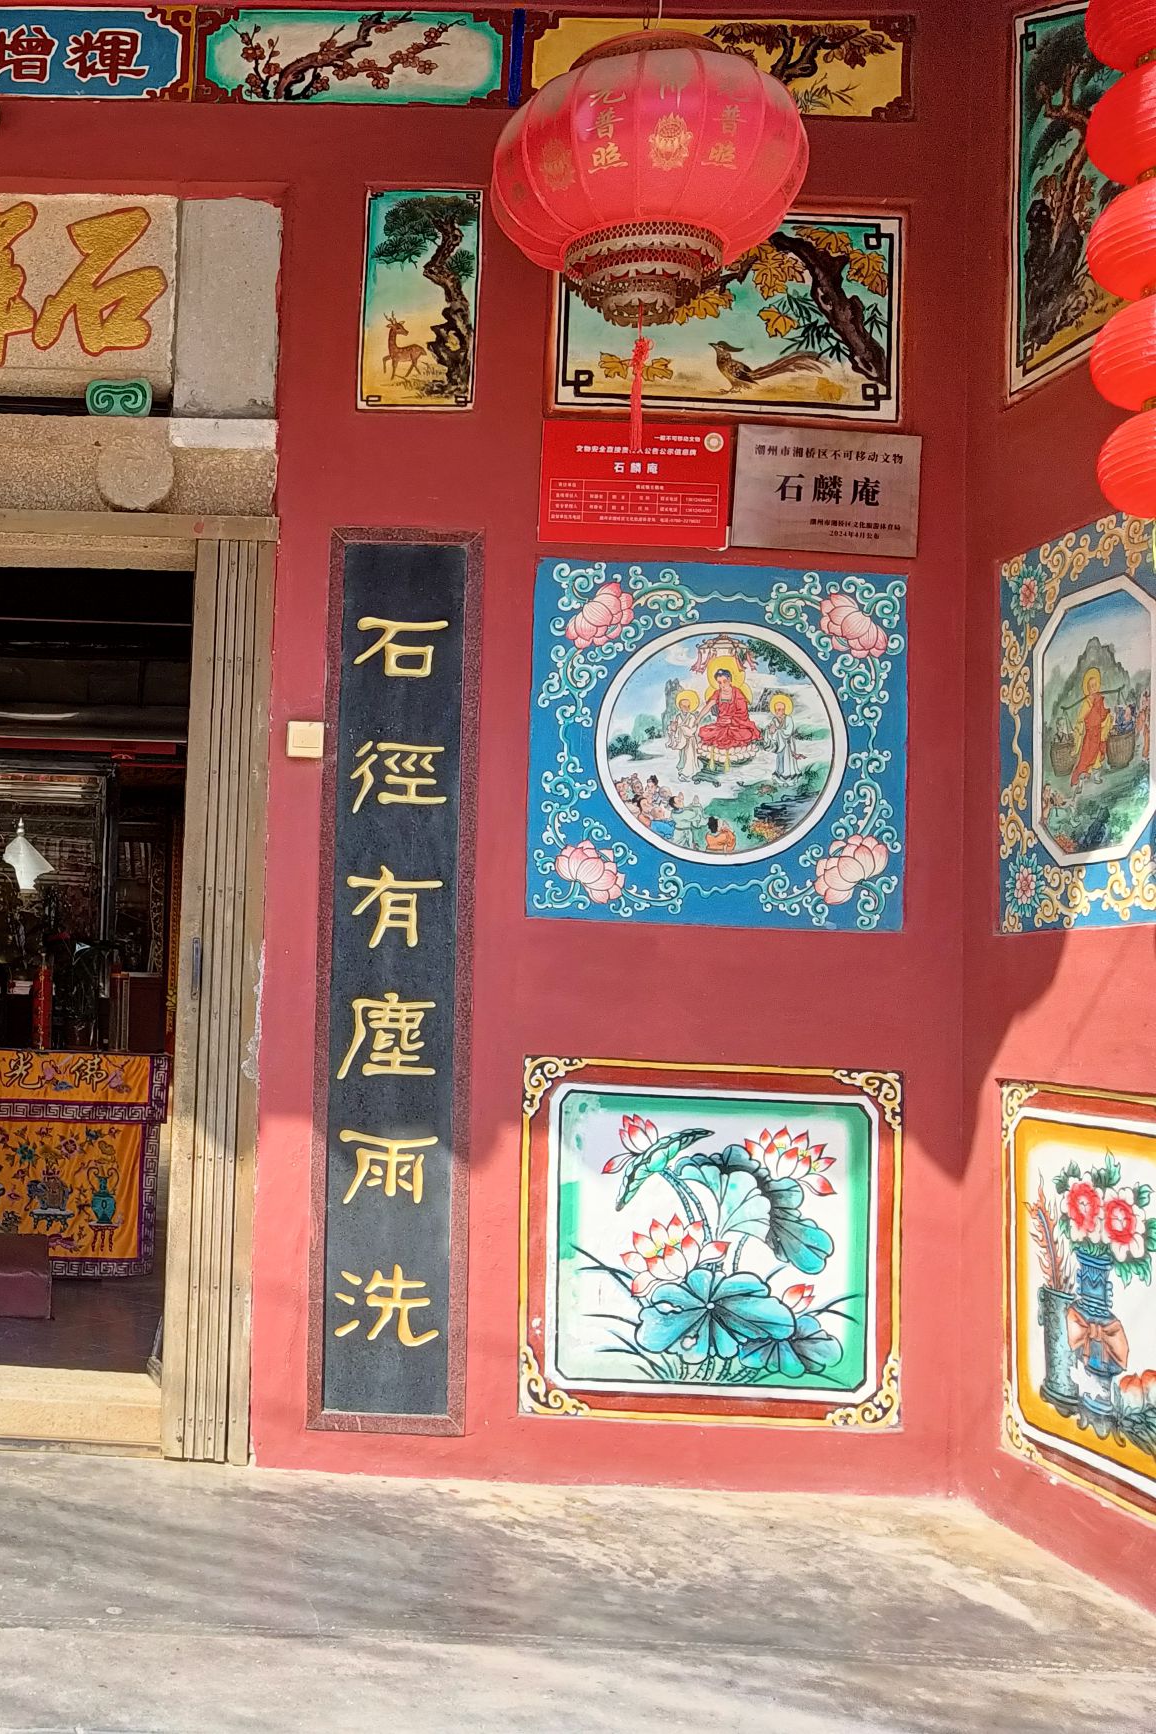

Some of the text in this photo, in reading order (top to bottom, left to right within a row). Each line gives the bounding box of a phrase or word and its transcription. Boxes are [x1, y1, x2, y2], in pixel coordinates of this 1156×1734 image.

[613, 461, 659, 475] 石麟庵
[754, 444, 904, 465] 潮州市湘桥区不可移动文物
[774, 473, 882, 508] 石麟庵
[333, 616, 450, 1348] 石徑有塵雨洗
